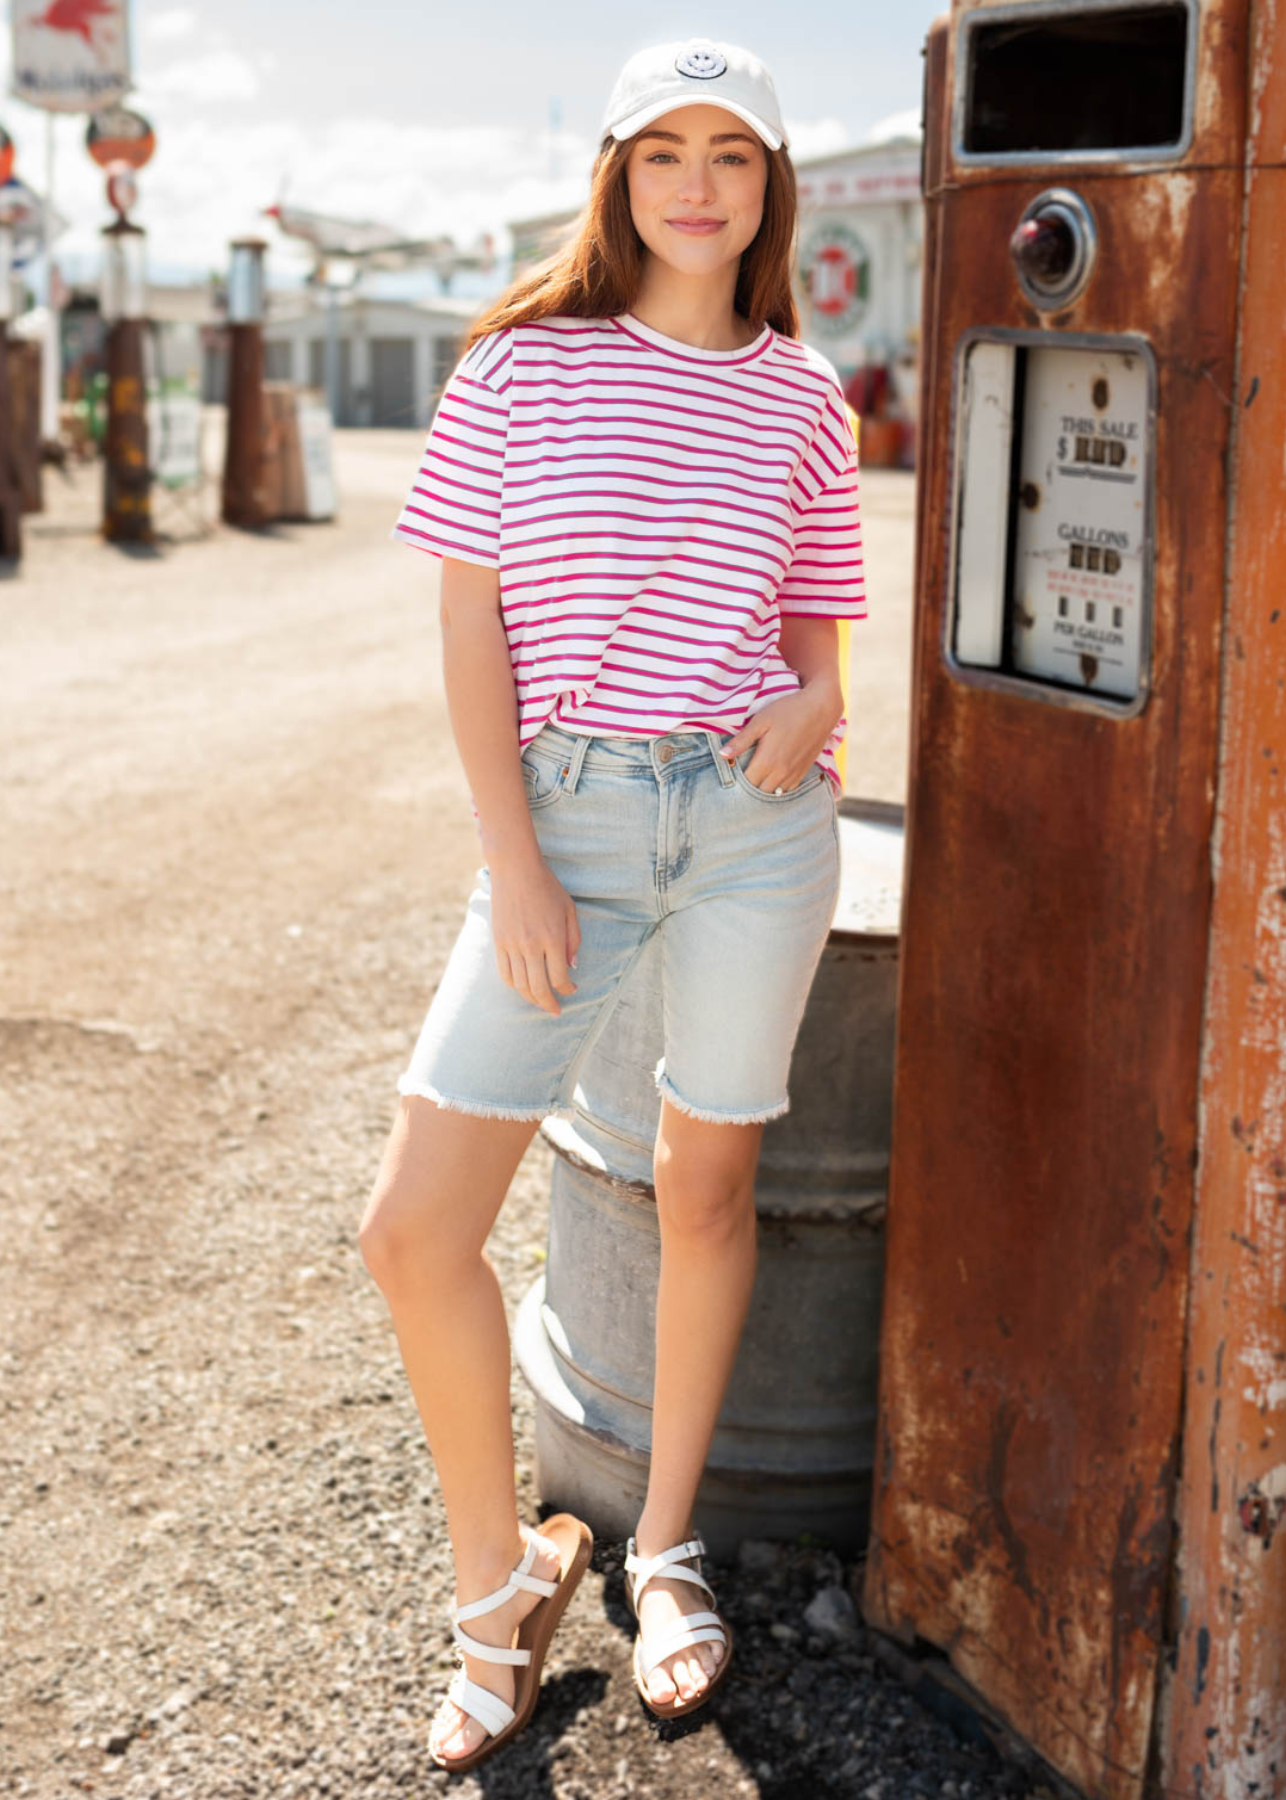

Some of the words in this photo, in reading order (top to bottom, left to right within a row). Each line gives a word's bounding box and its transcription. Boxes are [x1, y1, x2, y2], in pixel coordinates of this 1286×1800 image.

[1060, 416, 1095, 433] THIS
[1099, 420, 1139, 440] SALE
[1057, 436, 1067, 460] $
[1057, 523, 1129, 548] GALLONS
[1053, 621, 1075, 637] PER
[1078, 624, 1124, 646] GALLON
